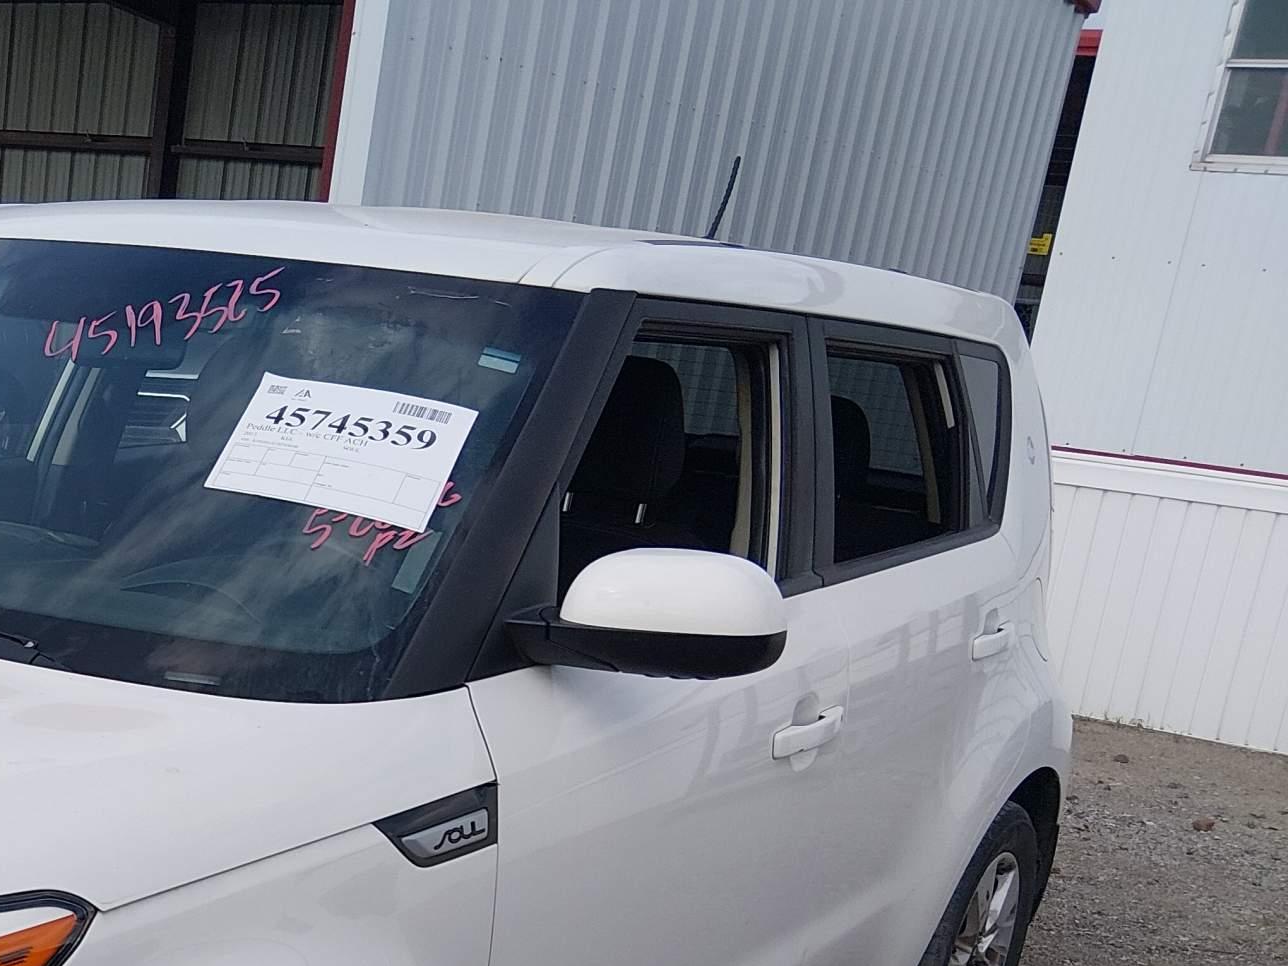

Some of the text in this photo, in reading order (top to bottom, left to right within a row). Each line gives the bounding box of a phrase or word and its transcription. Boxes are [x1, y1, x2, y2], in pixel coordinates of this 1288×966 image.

[246, 422, 276, 434] Peddle
[277, 426, 297, 436] LLC
[344, 436, 369, 448] ACH
[265, 405, 437, 450] 45745359
[434, 820, 486, 850] SOUL
